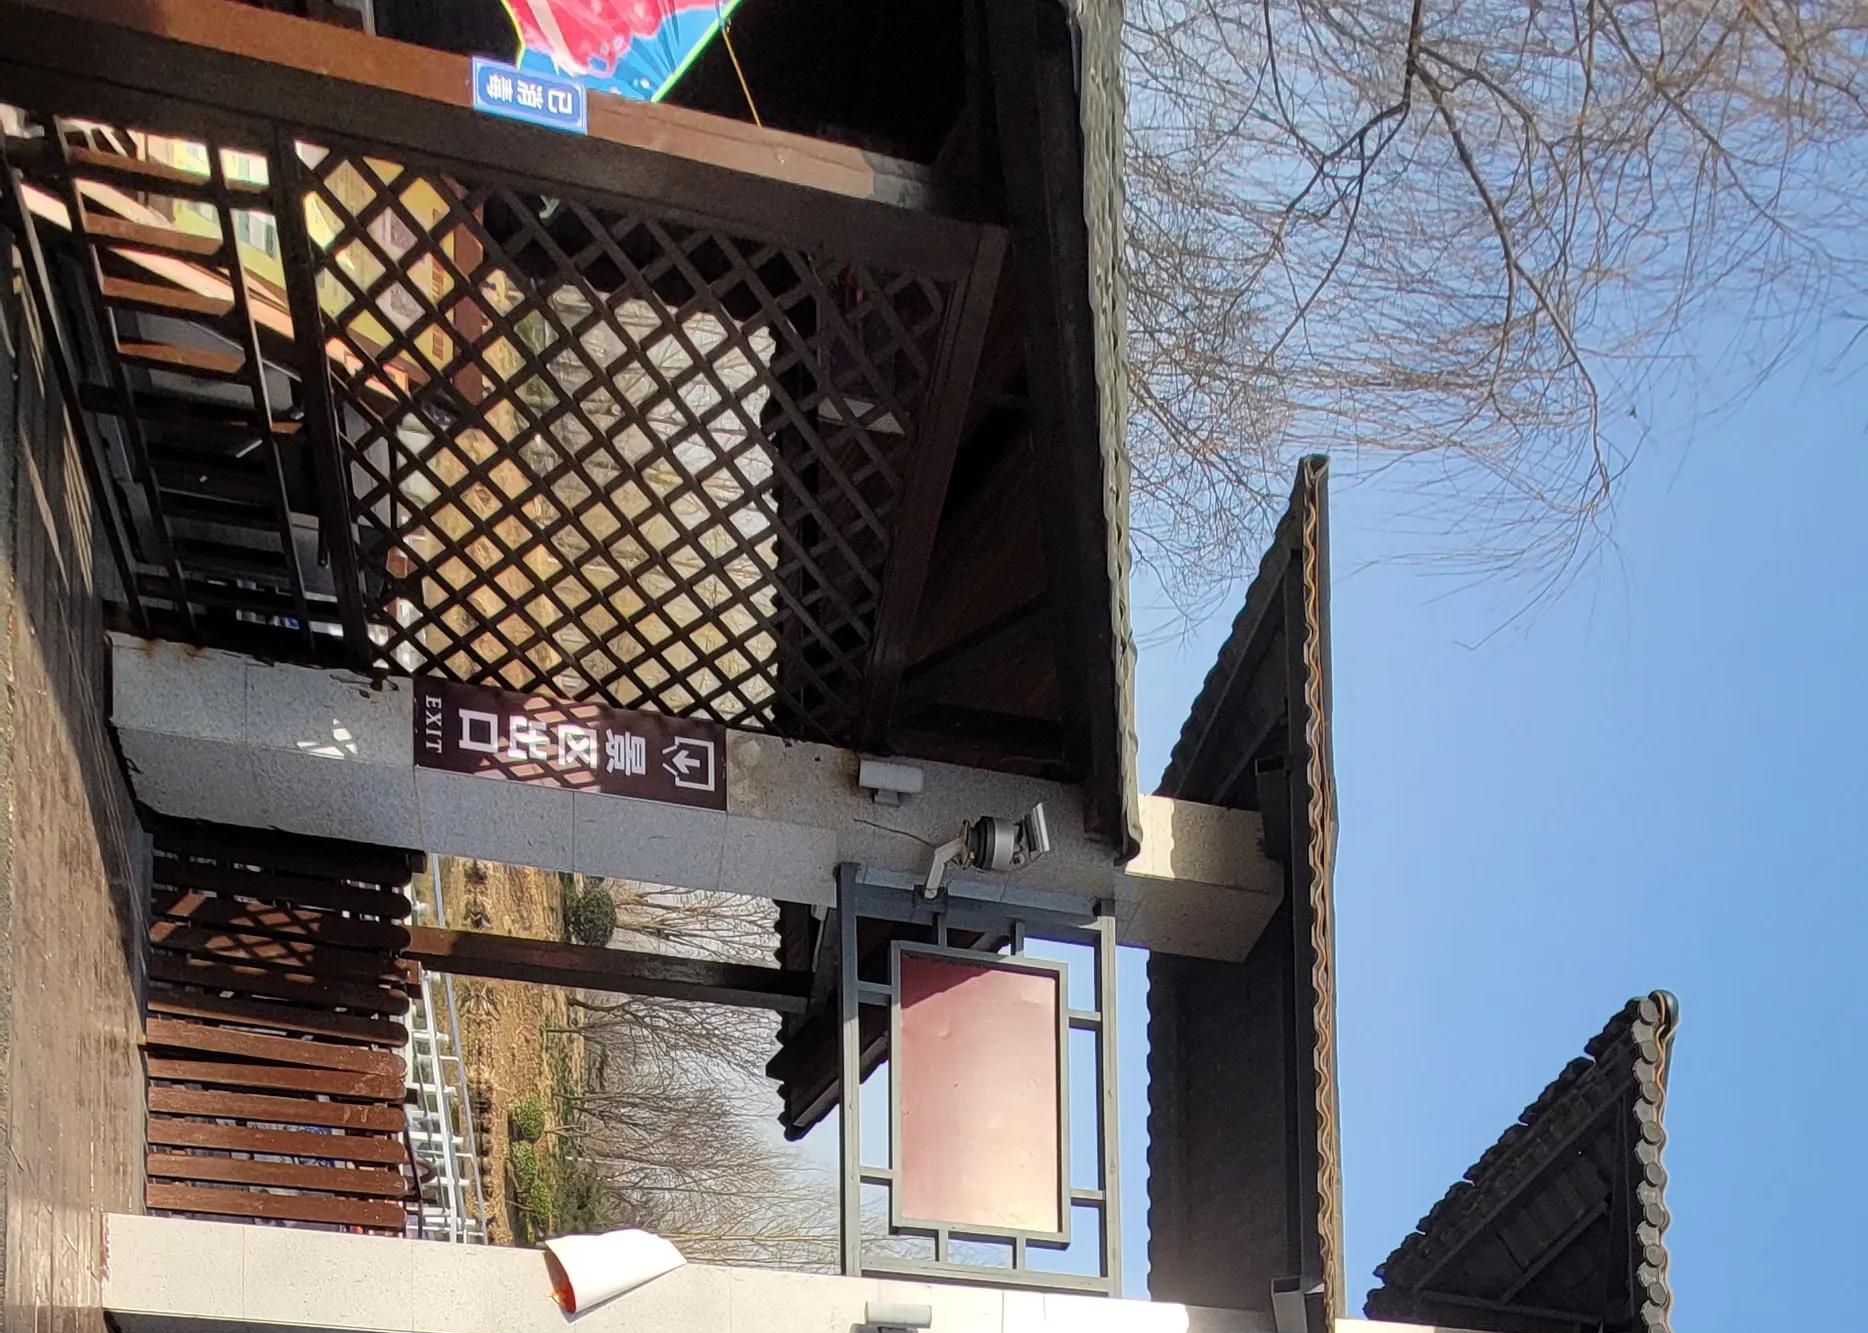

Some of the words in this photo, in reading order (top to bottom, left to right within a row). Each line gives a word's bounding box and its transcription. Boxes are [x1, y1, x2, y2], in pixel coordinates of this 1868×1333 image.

[486, 74, 573, 115] 已消毒
[424, 695, 442, 753] EXIT
[458, 708, 646, 776] 景区出口
